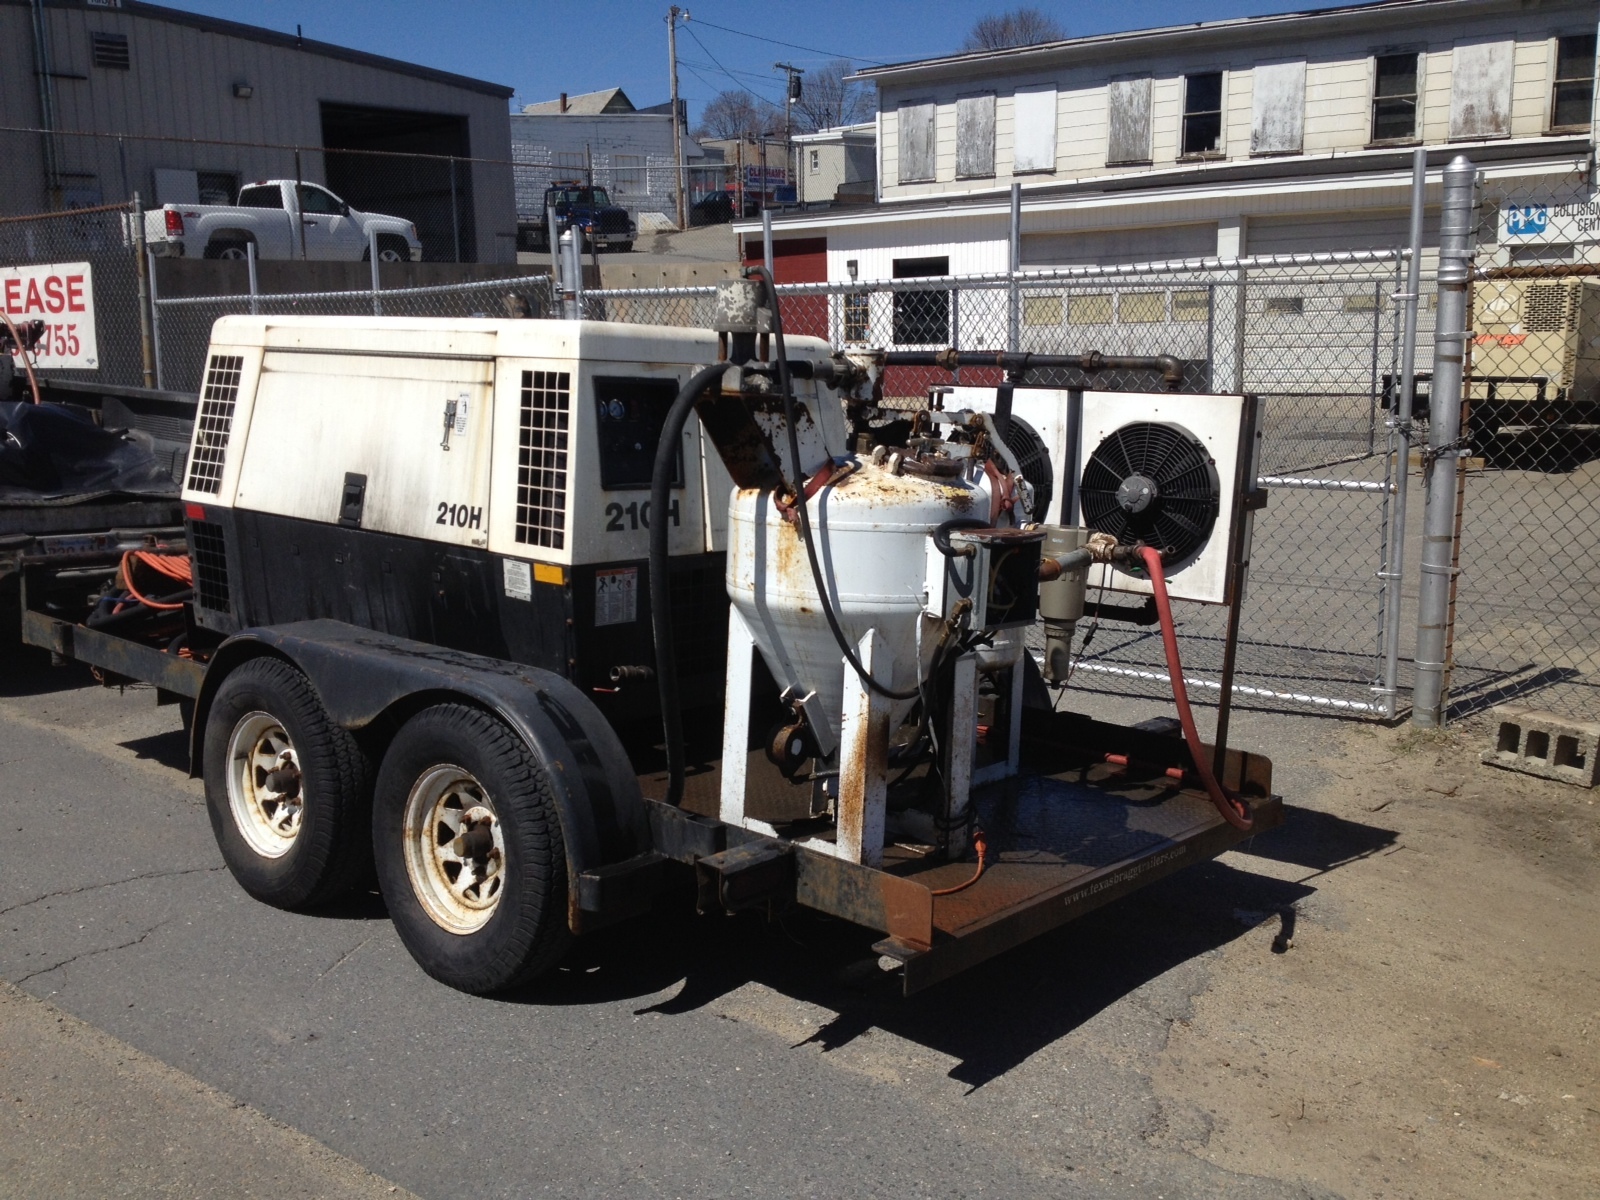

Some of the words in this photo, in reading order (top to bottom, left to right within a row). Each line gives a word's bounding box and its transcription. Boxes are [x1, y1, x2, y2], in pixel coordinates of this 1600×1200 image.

[1508, 205, 1547, 230] PPG
[1553, 202, 1600, 218] COLLISION
[0, 275, 85, 314] EASE
[436, 501, 483, 530] 210H
[1063, 844, 1187, 906] www.texasbraggtrailers.com
